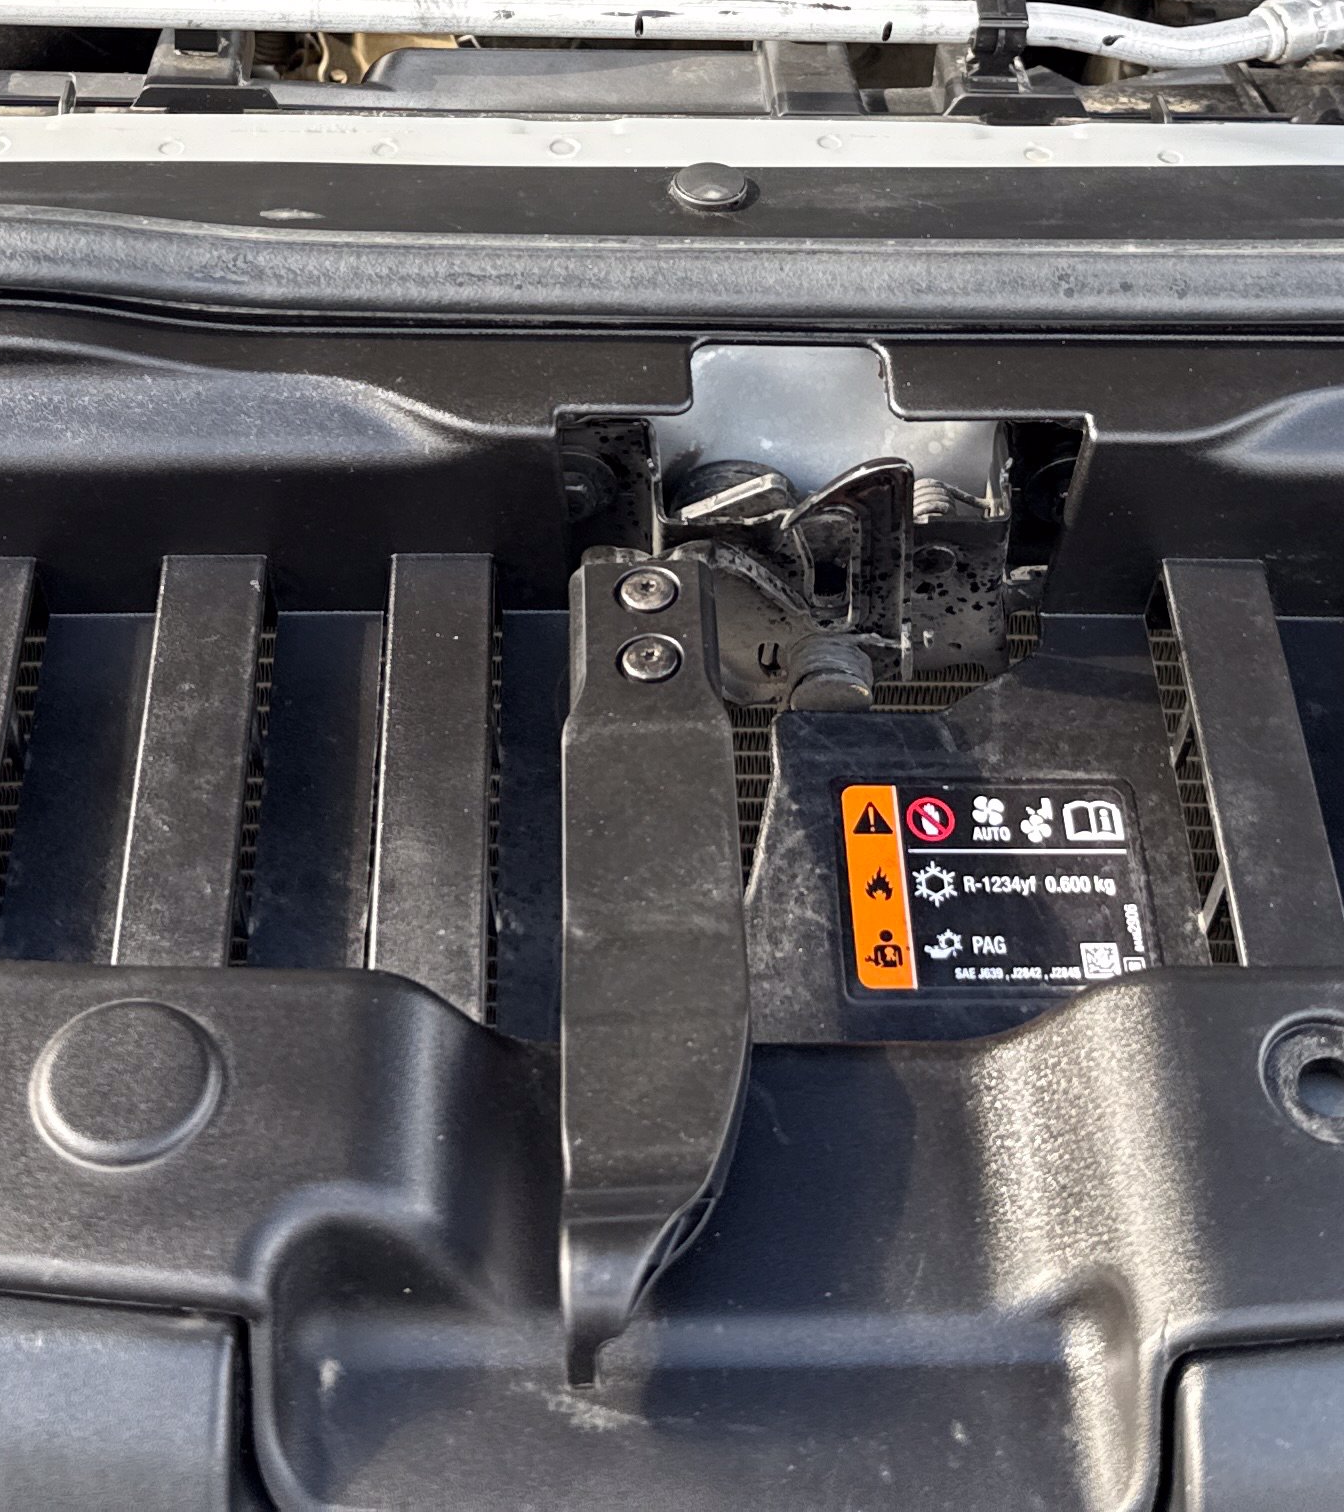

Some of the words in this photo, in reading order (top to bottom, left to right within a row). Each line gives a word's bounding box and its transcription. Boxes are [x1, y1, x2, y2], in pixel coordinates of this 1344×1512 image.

[972, 826, 1011, 841] AUTO
[963, 875, 1036, 896] R-1234yf
[1044, 875, 1091, 893] 0.600
[1094, 875, 1117, 896] kg
[972, 935, 1007, 955] PAG
[955, 967, 976, 980] SAE
